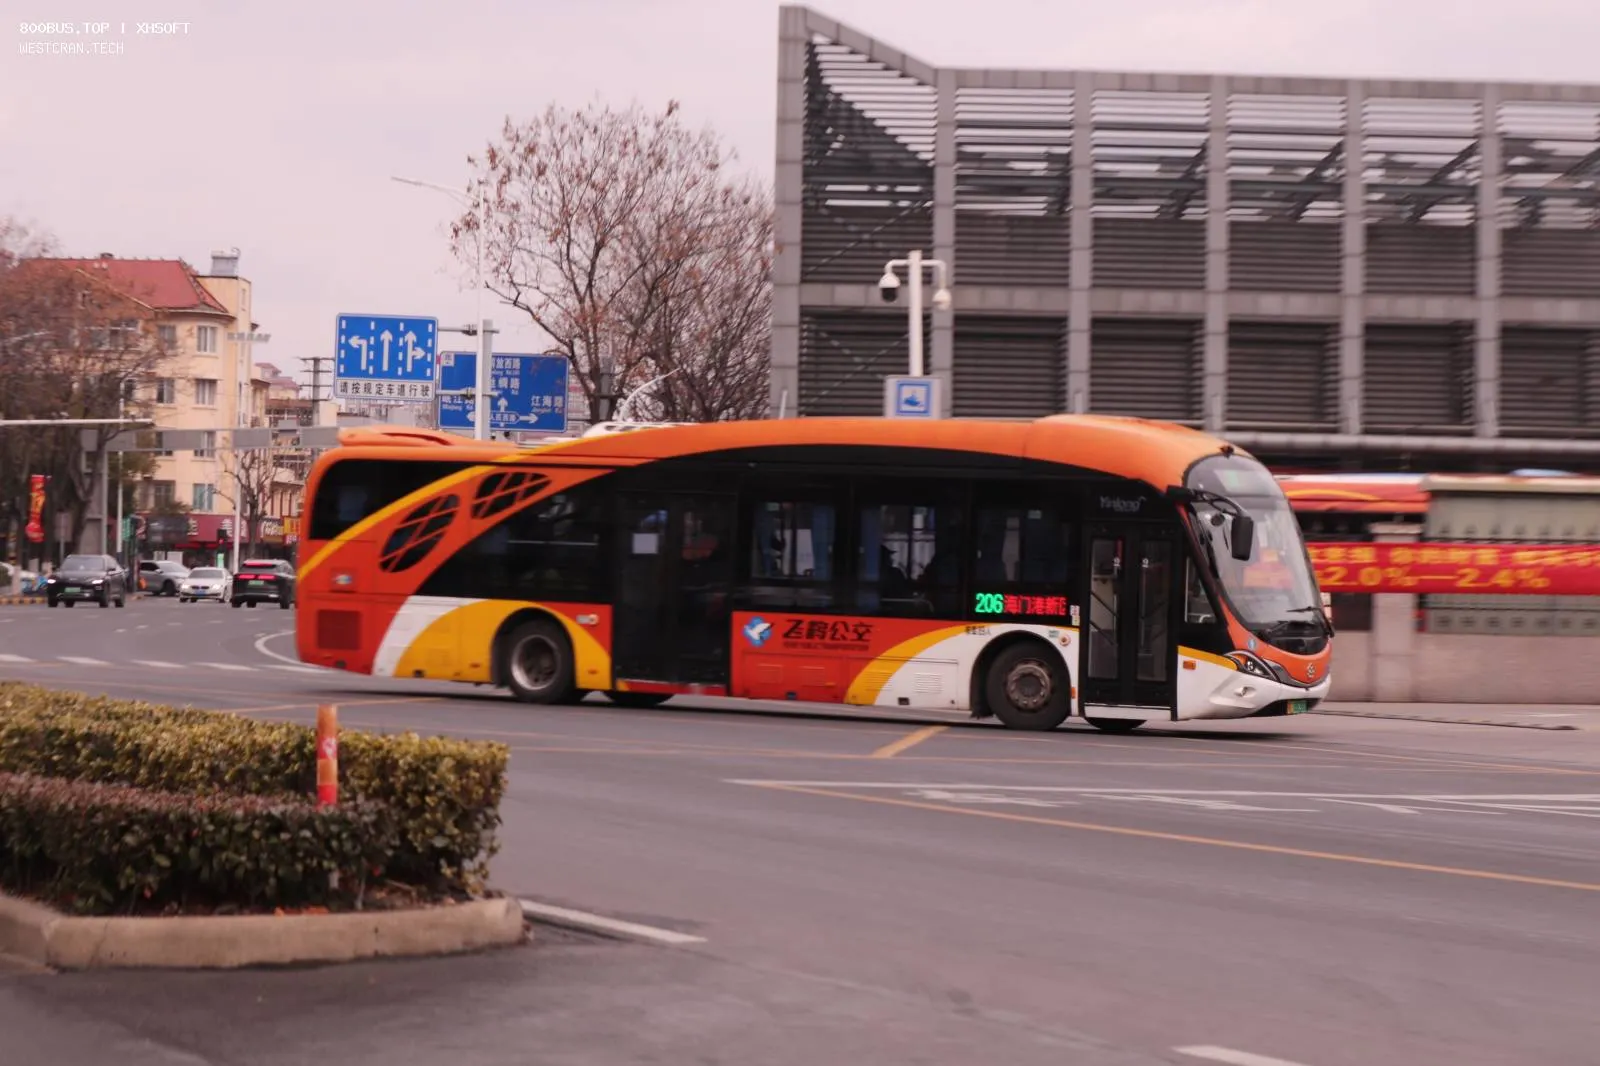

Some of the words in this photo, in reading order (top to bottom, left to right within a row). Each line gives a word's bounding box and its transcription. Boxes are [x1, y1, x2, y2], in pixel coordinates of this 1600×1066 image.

[340, 382, 430, 397] 请按规定车道行驶
[975, 592, 1004, 614] 206
